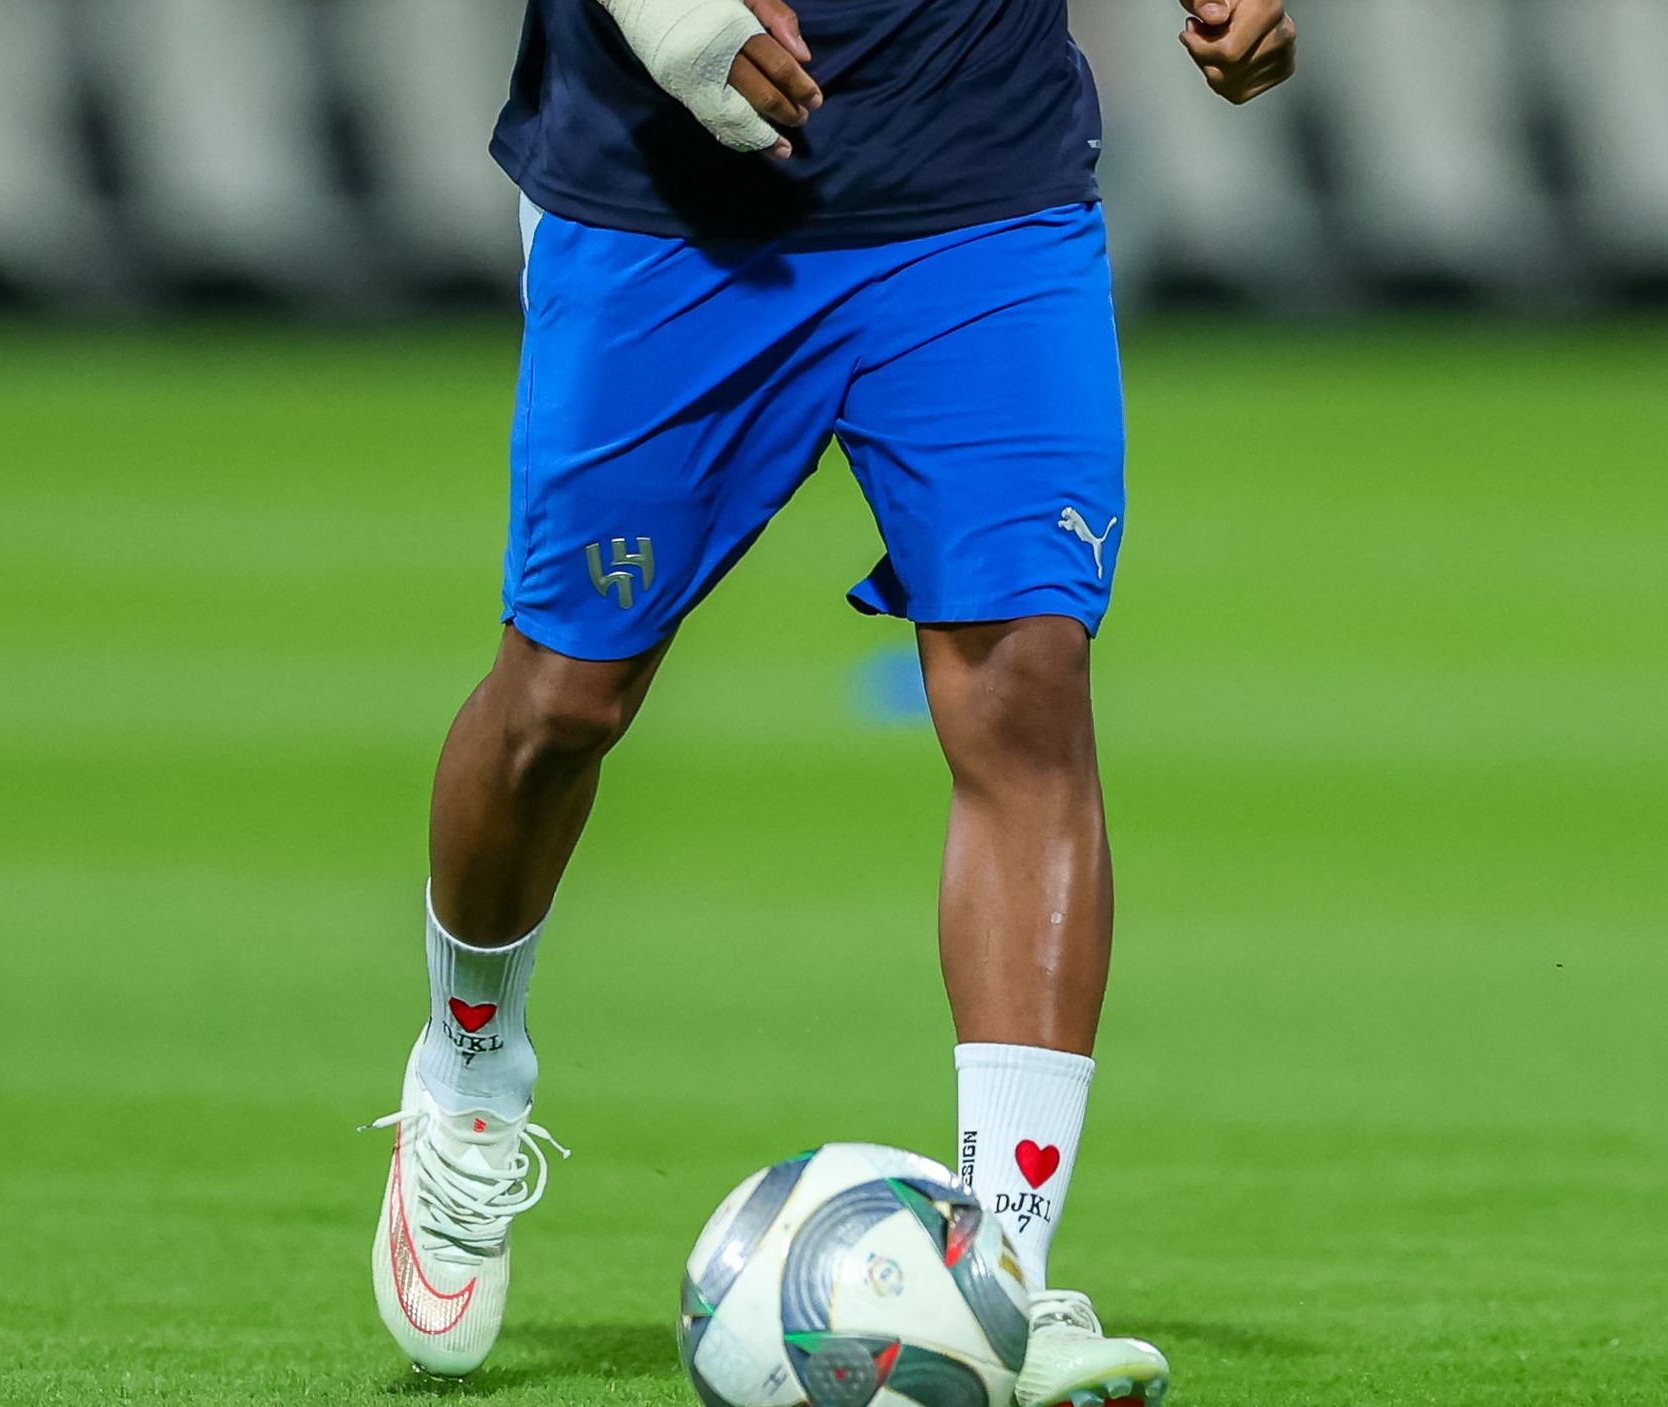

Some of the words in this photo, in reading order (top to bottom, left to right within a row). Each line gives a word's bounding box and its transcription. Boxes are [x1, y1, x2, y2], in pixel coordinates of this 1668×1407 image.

[442, 1020, 504, 1052] DJKL
[461, 1050, 476, 1066] 7
[993, 1192, 1052, 1224] DJKL
[1017, 1214, 1032, 1234] 7
